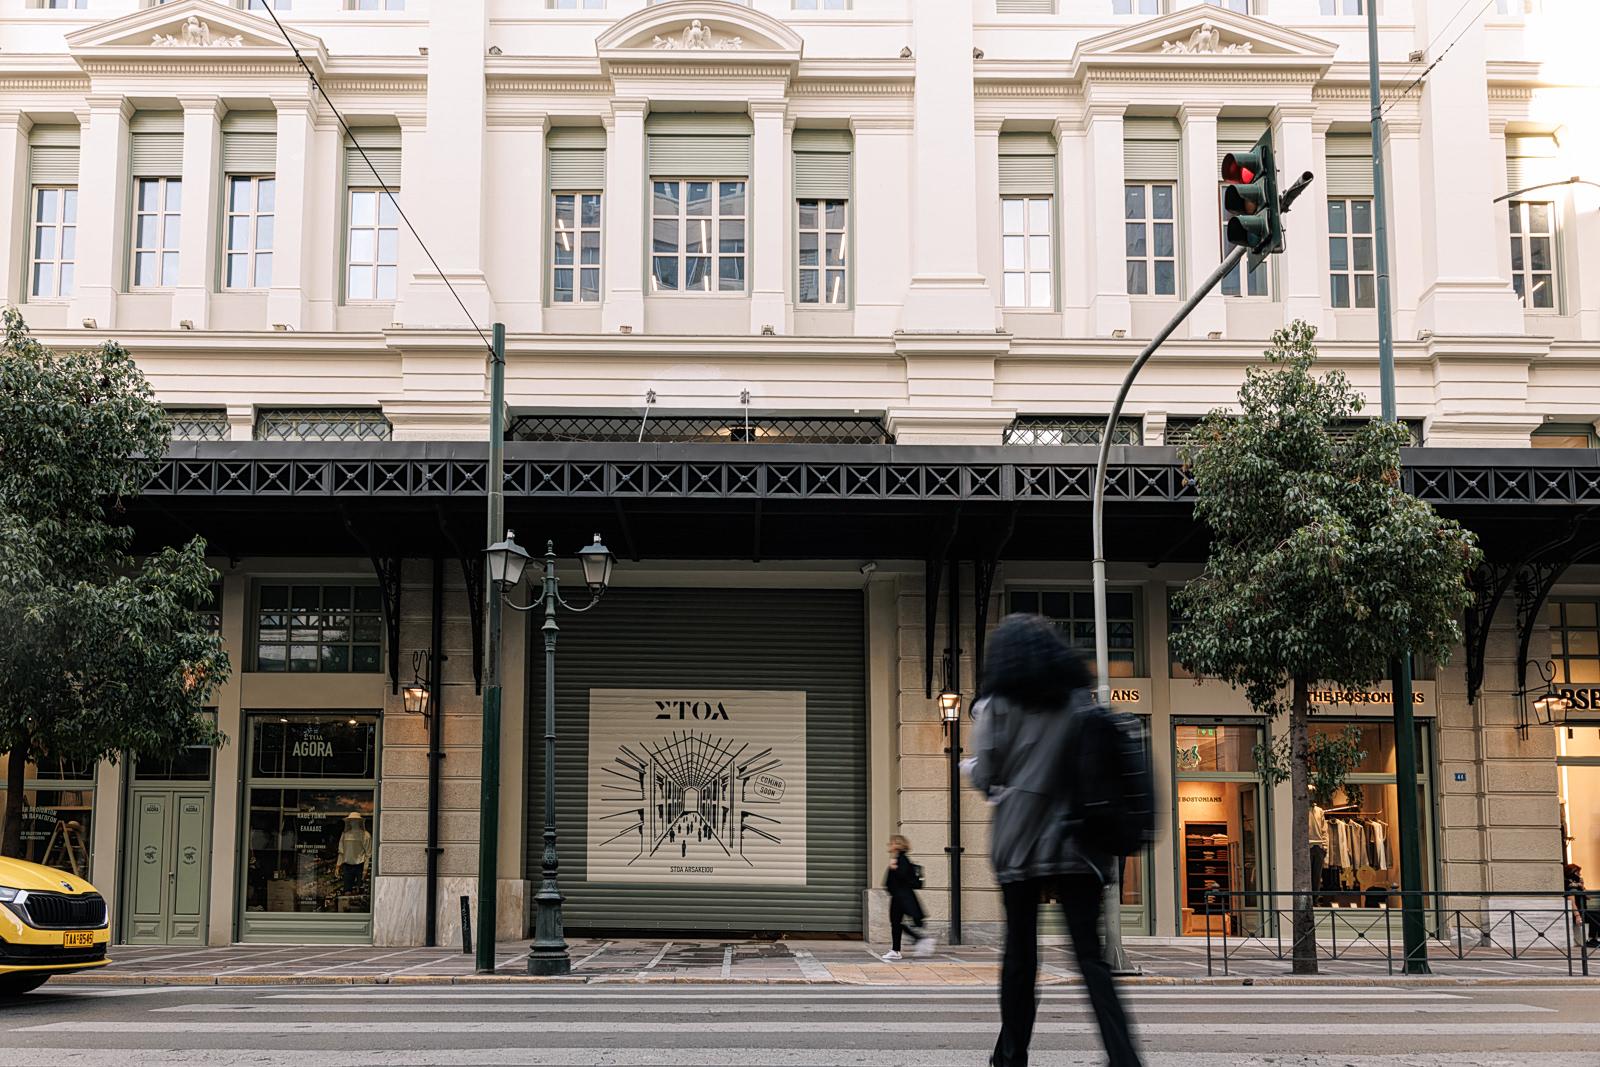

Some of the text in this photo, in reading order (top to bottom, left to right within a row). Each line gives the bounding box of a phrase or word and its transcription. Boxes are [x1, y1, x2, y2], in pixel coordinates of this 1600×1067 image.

[1335, 692, 1424, 703] BOSTONS
[292, 741, 333, 757] AGORA
[760, 786, 776, 796] SOON
